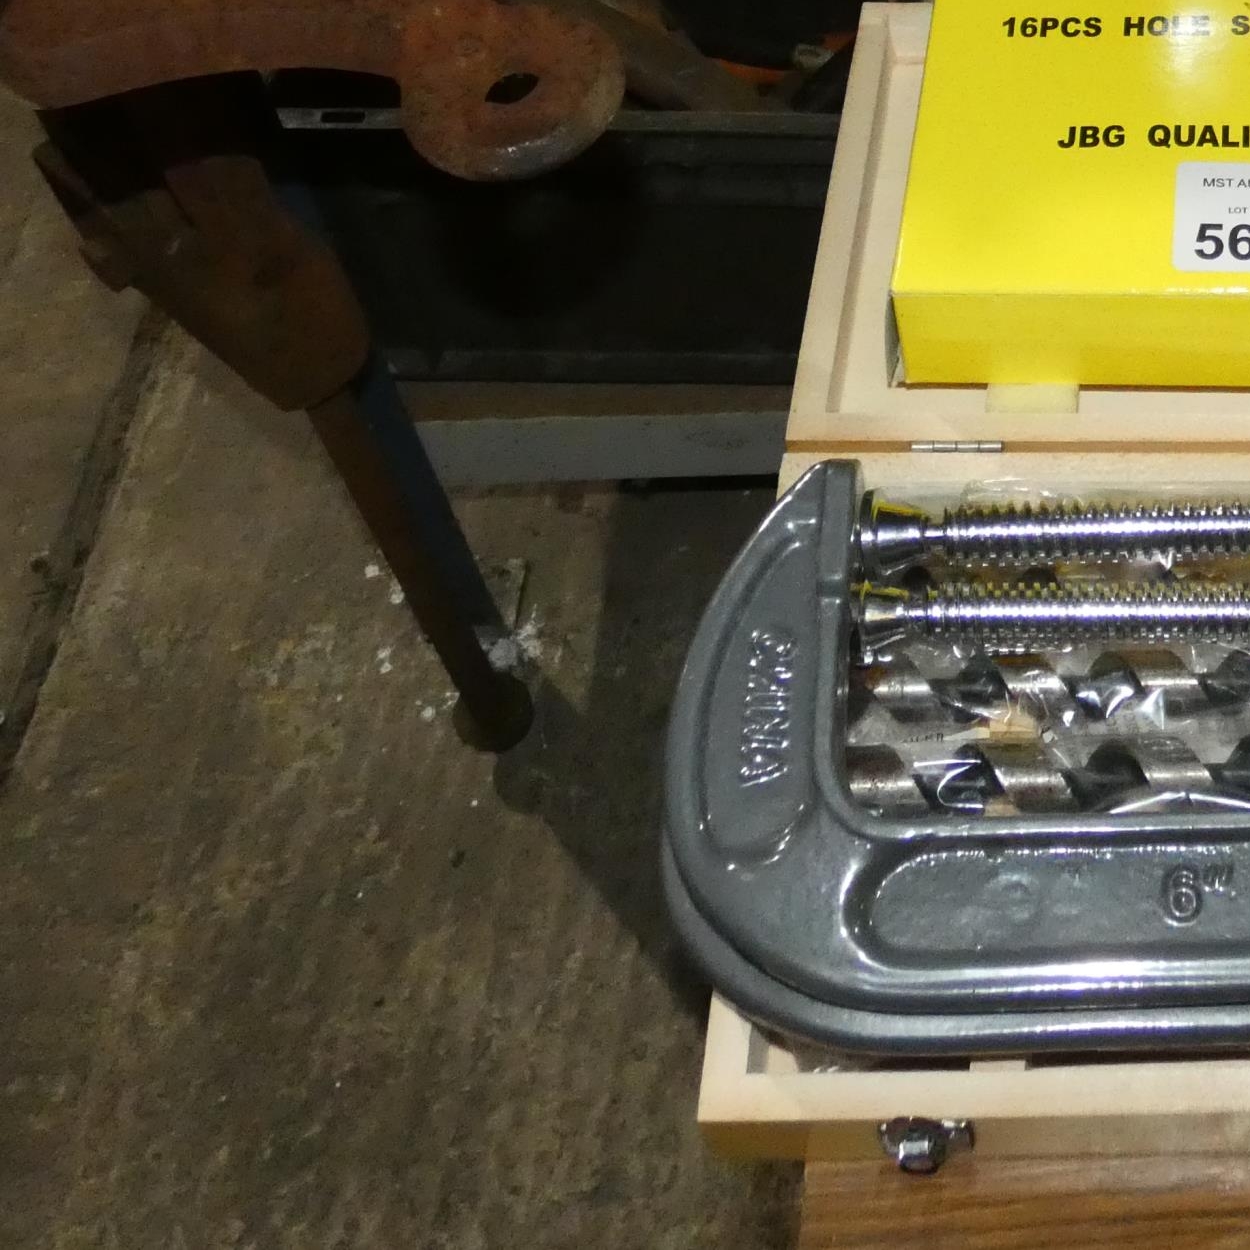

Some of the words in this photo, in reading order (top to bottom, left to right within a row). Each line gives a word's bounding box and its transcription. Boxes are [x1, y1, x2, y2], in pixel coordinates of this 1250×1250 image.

[1001, 16, 1102, 38] 16PCS
[1123, 15, 1210, 38] HOLE
[1058, 125, 1125, 149] JBG
[1202, 176, 1234, 189] MST
